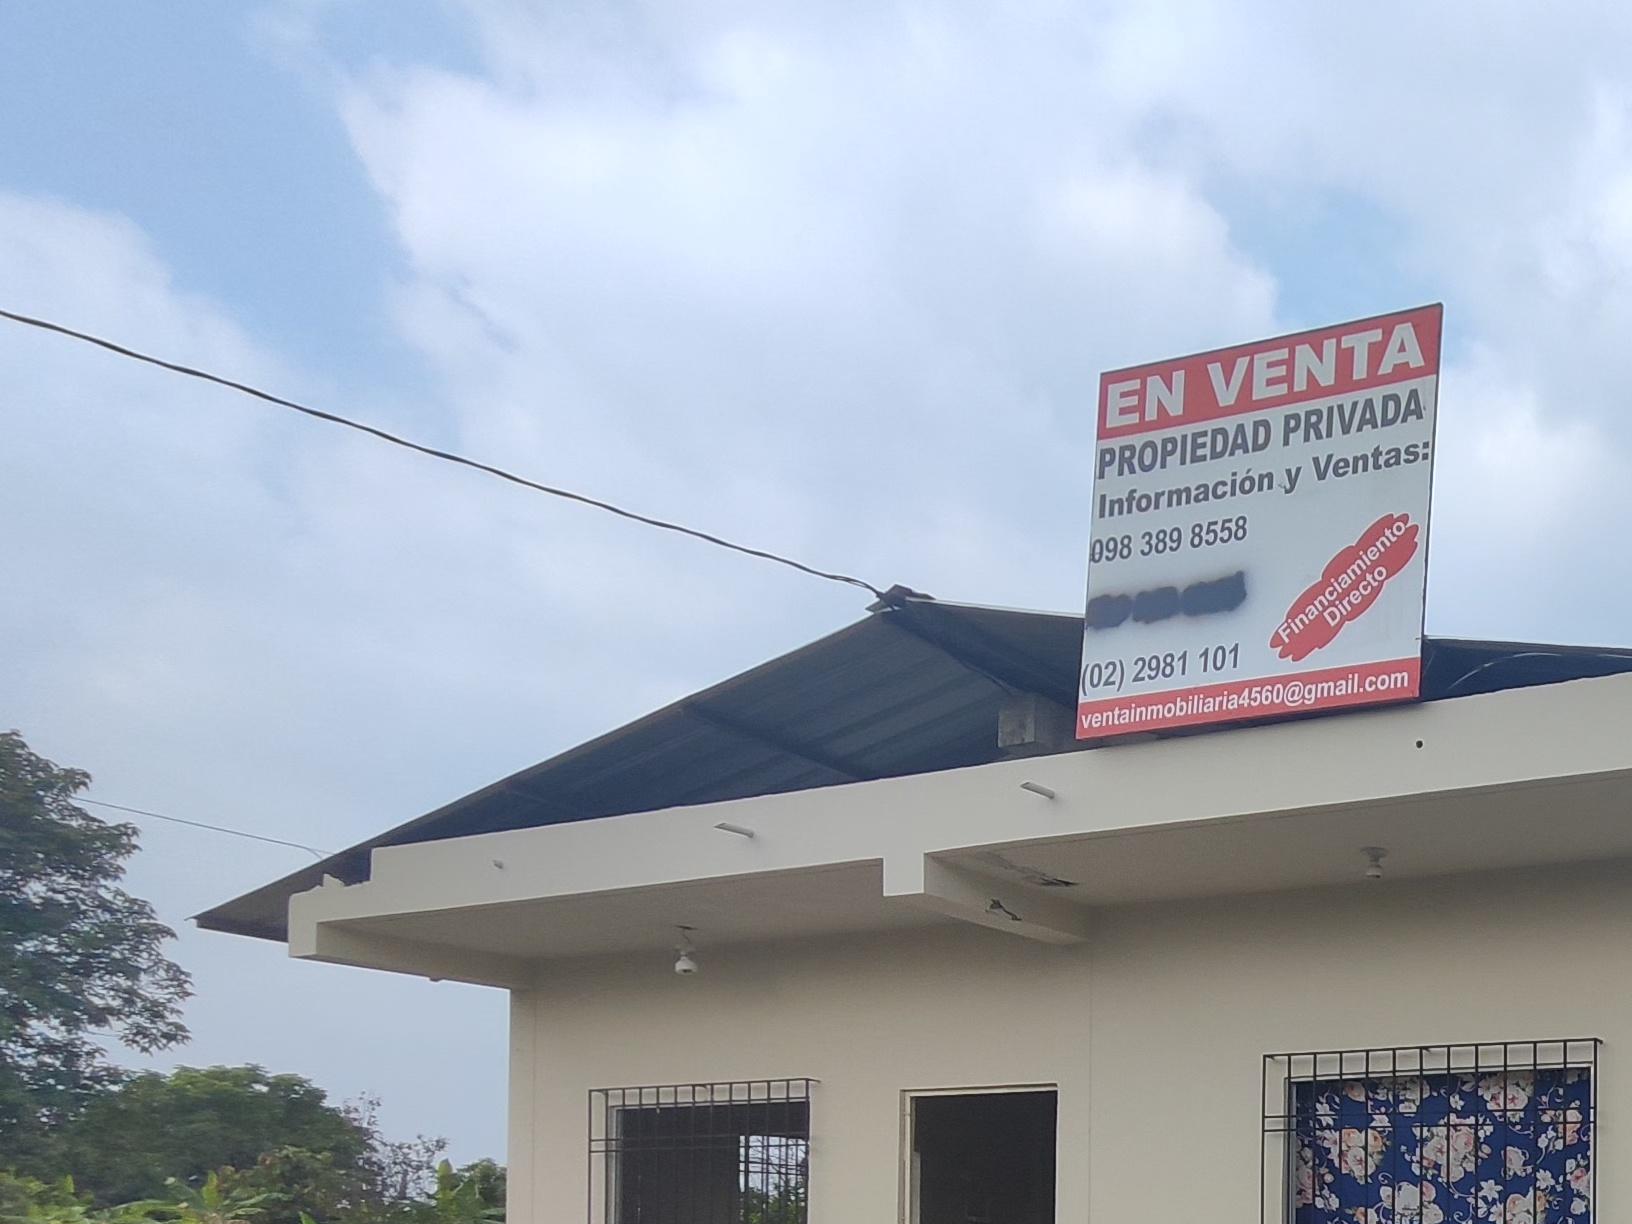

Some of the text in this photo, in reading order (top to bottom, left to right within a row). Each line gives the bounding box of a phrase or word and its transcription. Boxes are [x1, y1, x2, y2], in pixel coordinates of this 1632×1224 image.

[1106, 322, 1426, 428] EN VENTA
[1098, 388, 1424, 480] PROPIEDAD PRIVADA
[1098, 440, 1430, 519] Información y Ventas:
[1091, 515, 1248, 564] 098 389 8558
[1277, 520, 1407, 645] Financiamiento
[1323, 565, 1388, 628] Directo
[1081, 642, 1241, 697] (02) 2981 101
[1081, 669, 1409, 730] ventainmobiliaria4560@gmail.com
